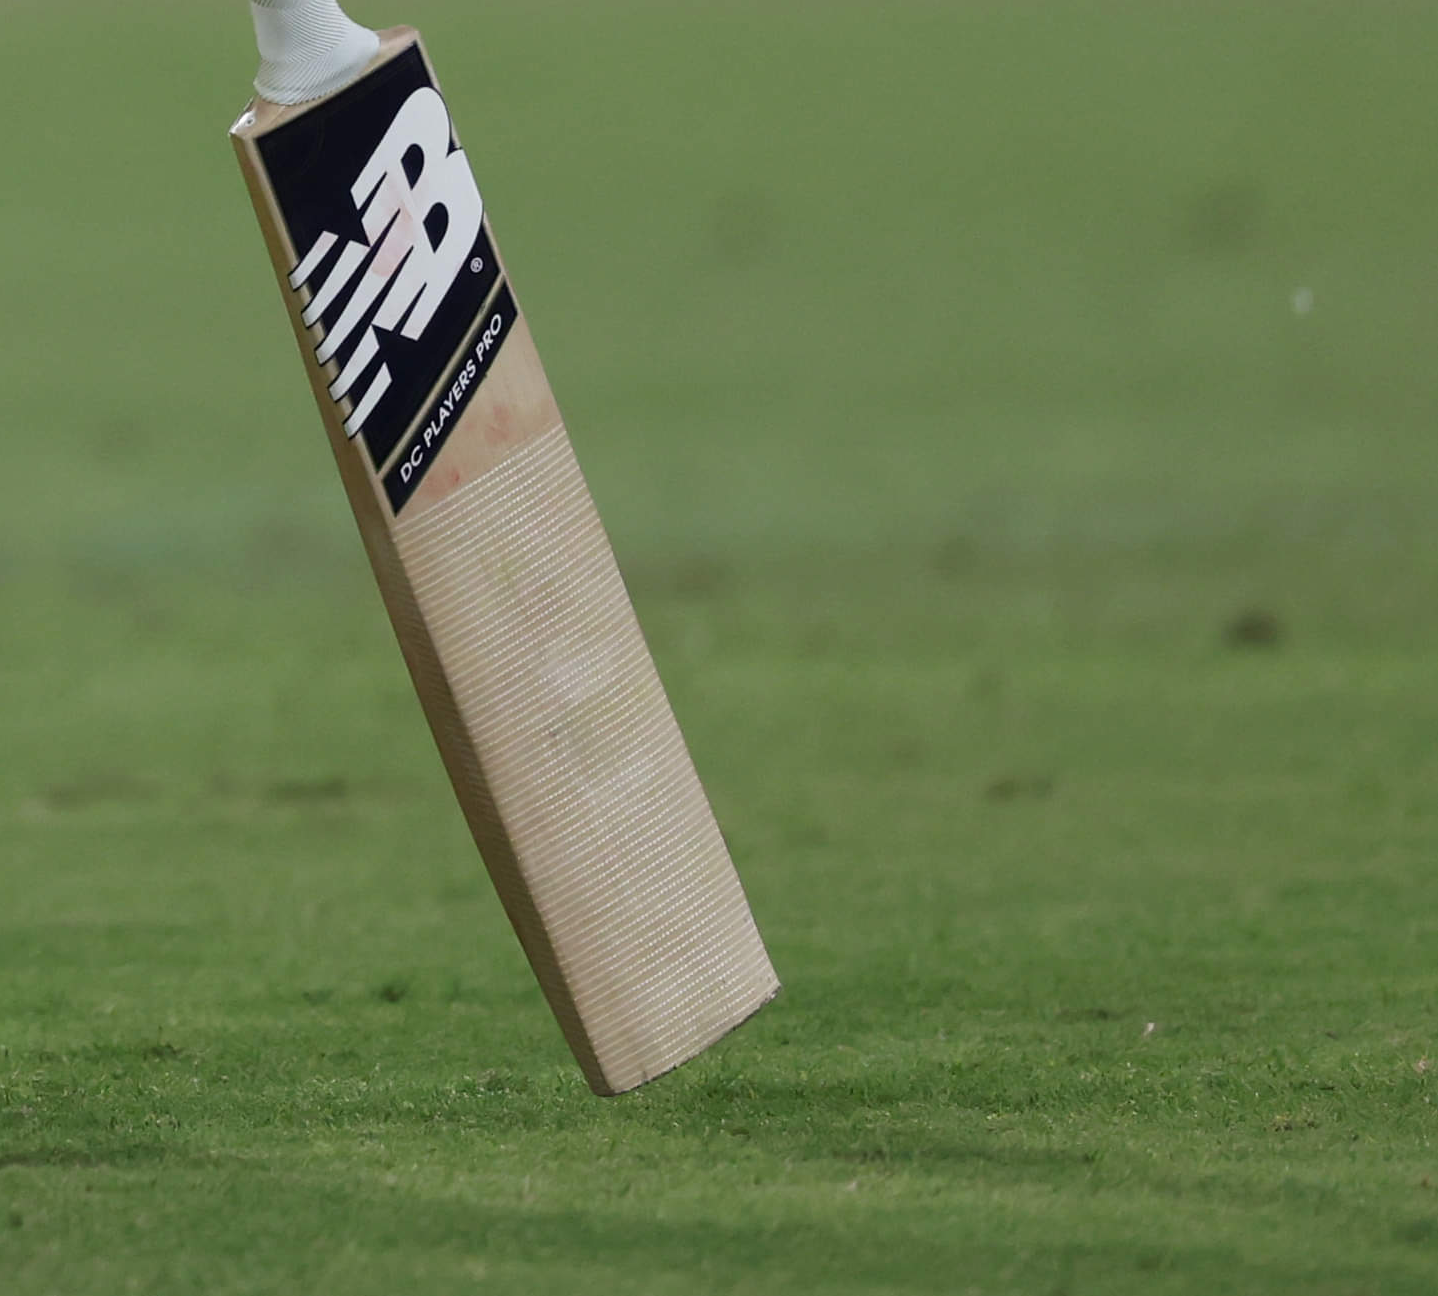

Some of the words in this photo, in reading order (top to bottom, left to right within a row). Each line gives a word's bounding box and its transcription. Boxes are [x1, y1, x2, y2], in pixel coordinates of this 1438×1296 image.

[400, 445, 424, 484] DC
[423, 359, 477, 448] PLAYERS
[475, 313, 502, 363] PRO
